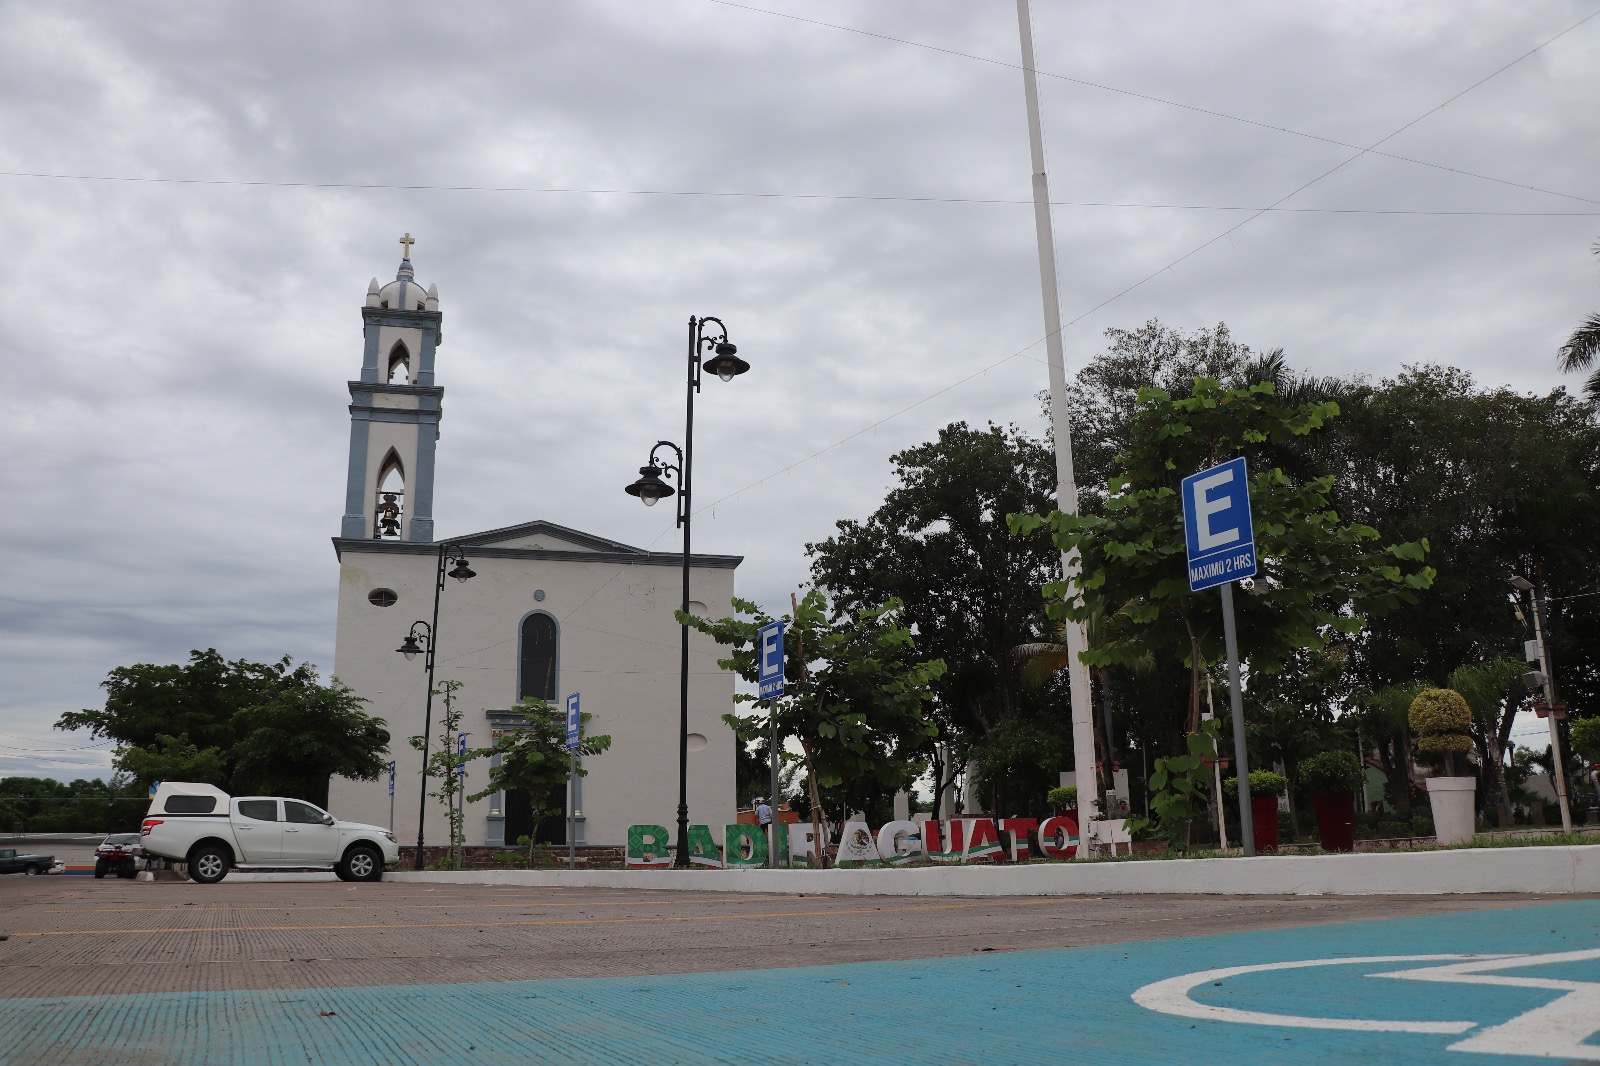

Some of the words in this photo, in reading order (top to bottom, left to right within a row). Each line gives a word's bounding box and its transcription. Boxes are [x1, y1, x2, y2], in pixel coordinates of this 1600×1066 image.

[1193, 469, 1239, 551] E
[1191, 560, 1224, 582] MAXIMO
[1226, 560, 1232, 572] 2
[1234, 553, 1254, 570] HRS.
[762, 626, 778, 676] E
[568, 696, 578, 731] E
